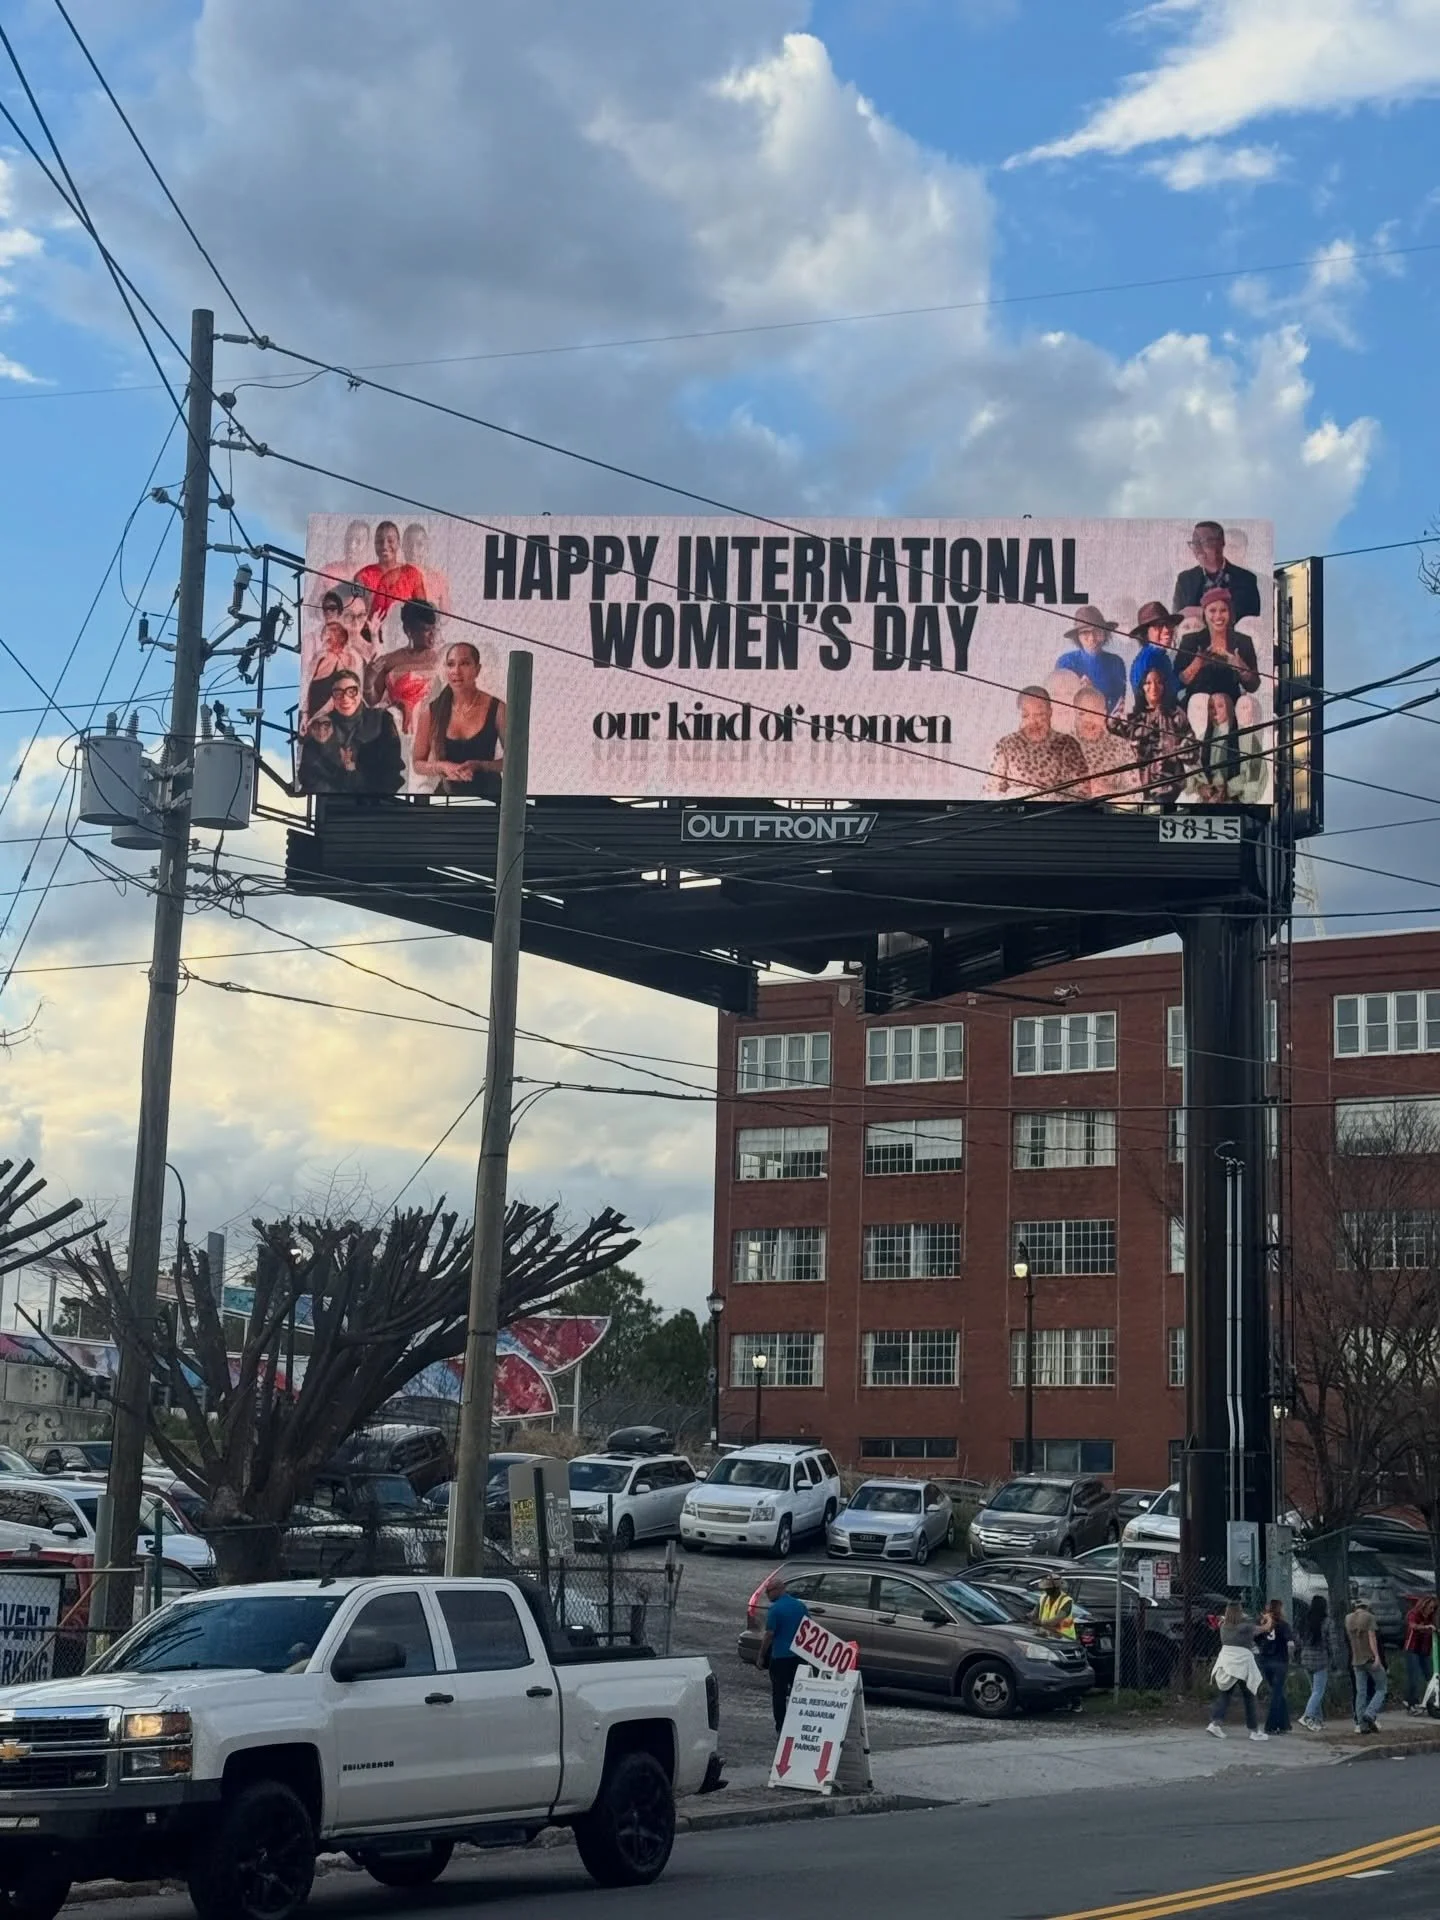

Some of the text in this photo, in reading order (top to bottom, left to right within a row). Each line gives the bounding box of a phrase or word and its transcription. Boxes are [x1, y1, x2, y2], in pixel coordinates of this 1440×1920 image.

[484, 534, 1089, 605] HAPPY INTERNATIONAL
[872, 606, 979, 673] DAY
[592, 701, 953, 744] our kind of women
[1161, 818, 1239, 840] 9815
[0, 1603, 50, 1641] VENT
[796, 1619, 852, 1674] $20.00
[804, 1710, 836, 1720] AQUARIUM
[809, 1698, 849, 1711] RESTAURANT
[800, 1733, 820, 1743] VALET
[801, 1724, 817, 1733] SELF
[794, 1743, 821, 1753] PARKING
